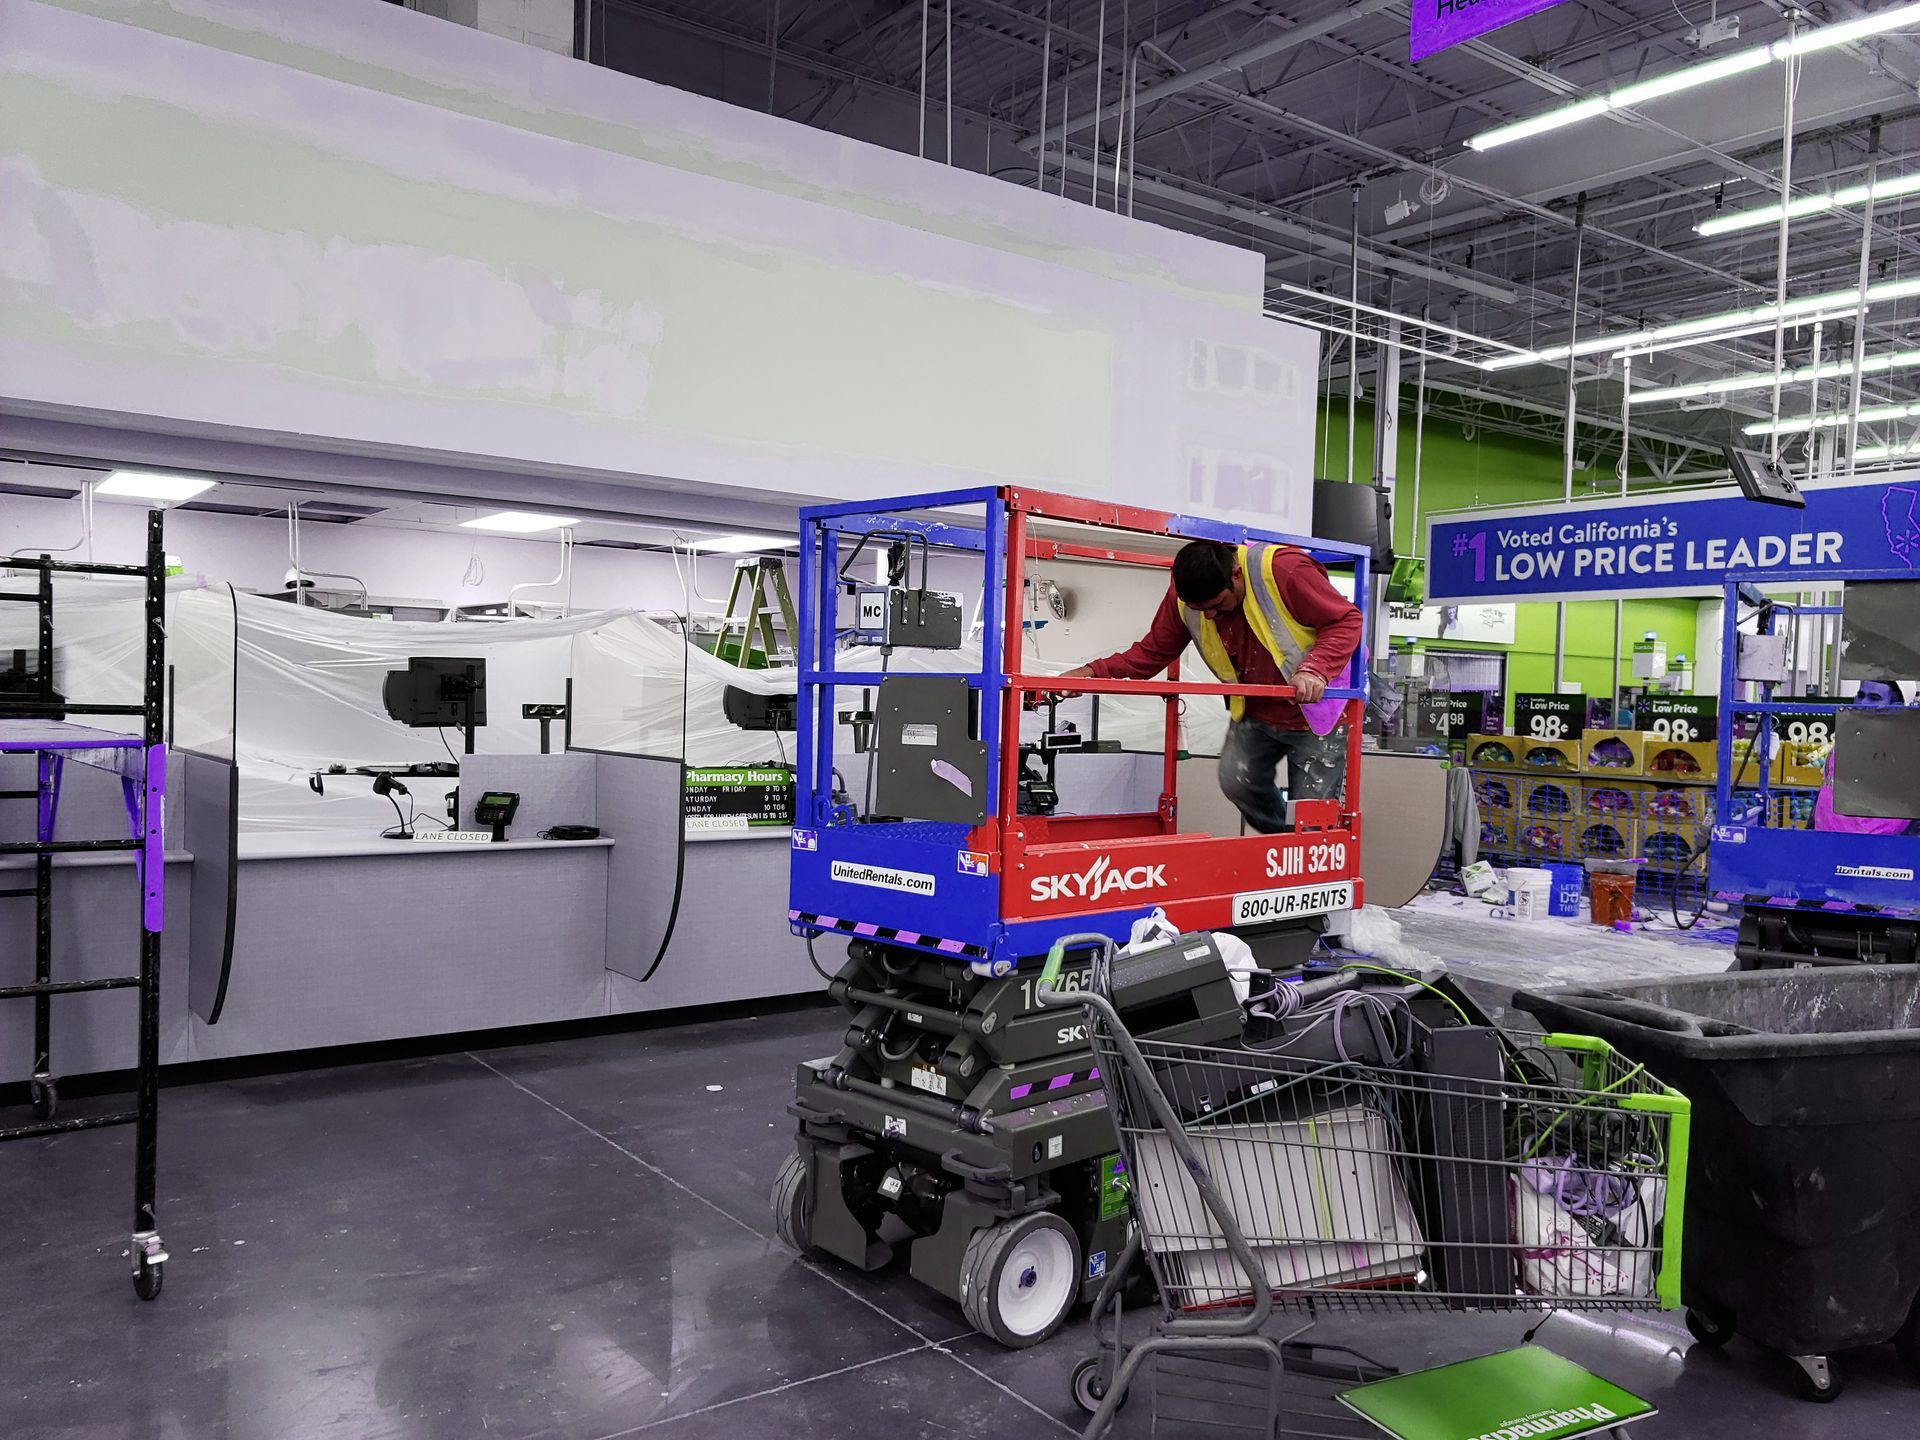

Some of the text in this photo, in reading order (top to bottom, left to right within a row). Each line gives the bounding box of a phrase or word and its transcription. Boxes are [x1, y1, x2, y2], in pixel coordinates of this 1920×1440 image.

[1498, 516, 1678, 548] Voted California's
[1452, 531, 1486, 582] #1
[1495, 532, 1843, 581] LOW PRICE LEADER
[863, 605, 881, 617] MC
[1530, 702, 1570, 710] Low Price
[1652, 704, 1698, 713] Low Price
[686, 771, 783, 784] Pharmacy Hours
[415, 832, 489, 841] LANE CLOSED
[686, 819, 745, 829] LANE CLOSED
[1308, 843, 1346, 873] 3219
[833, 865, 933, 891] UnitedRentals.com
[1030, 854, 1168, 901] SKYJACK
[1241, 888, 1347, 918] 800-UR-RENTS
